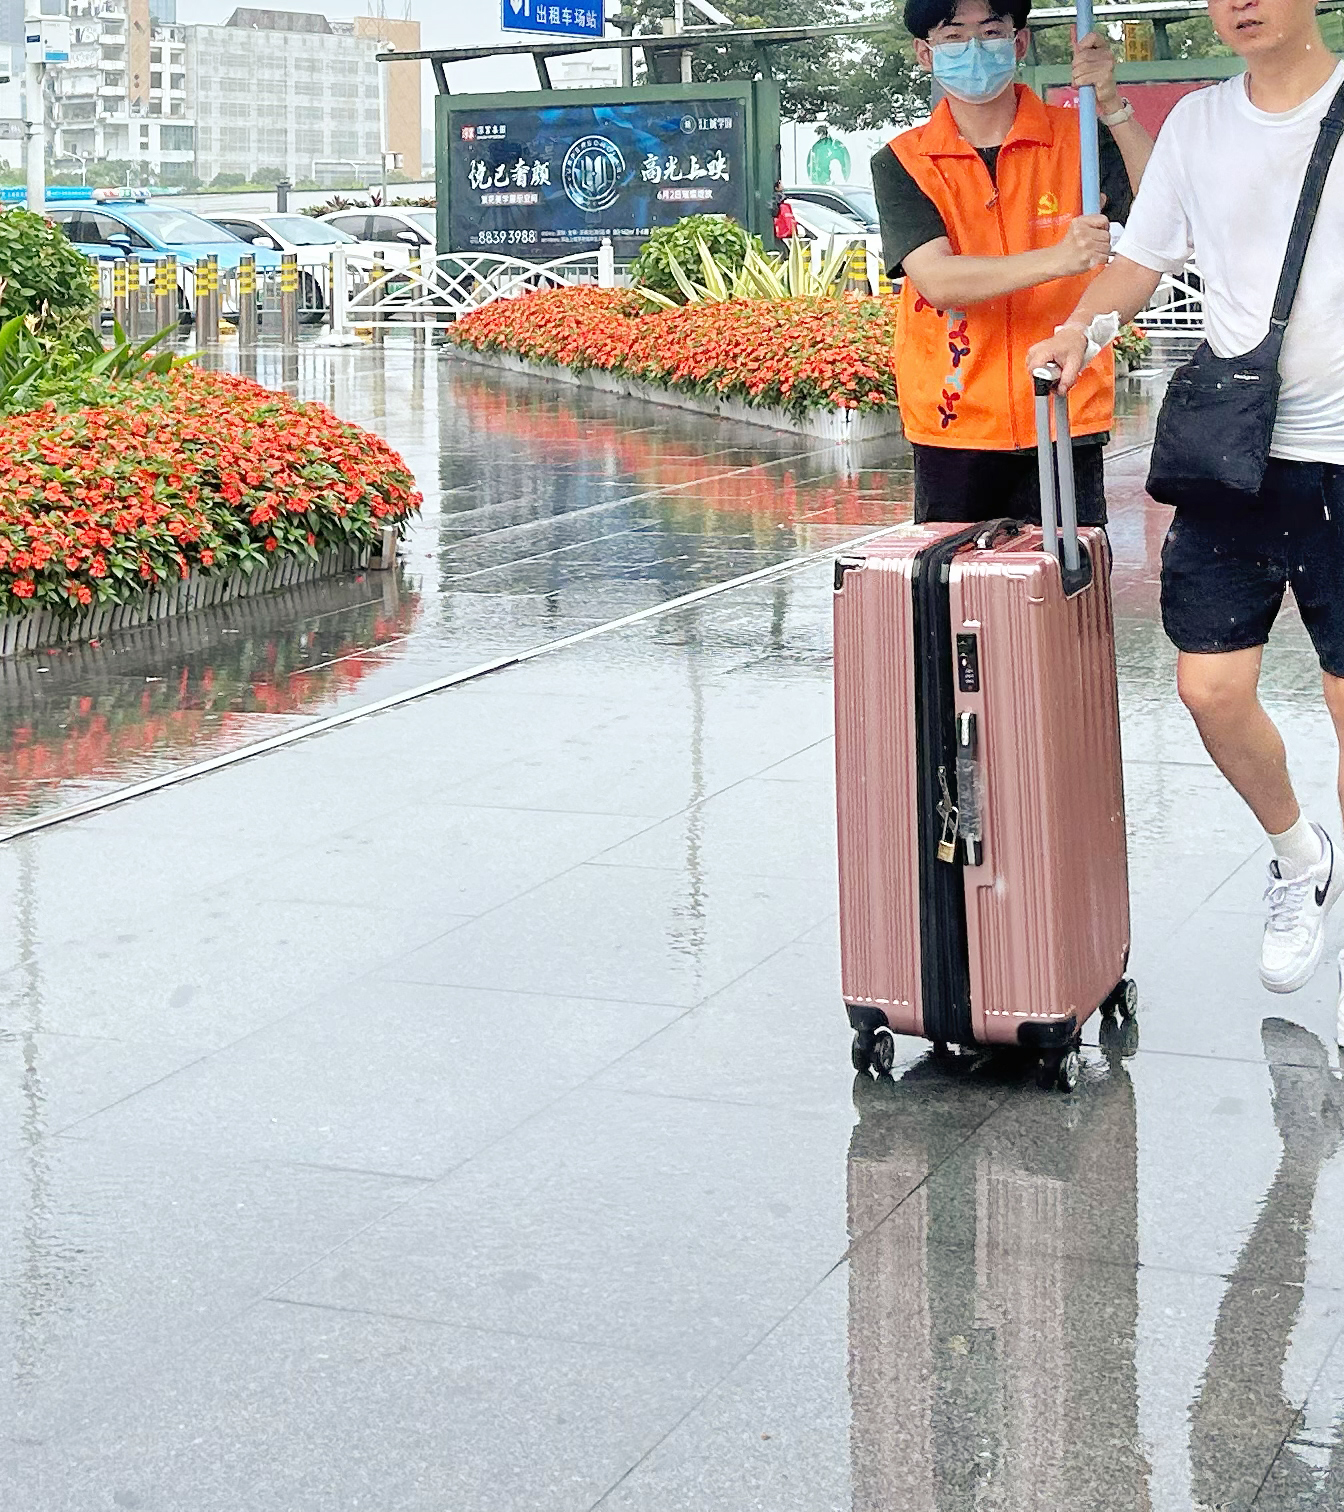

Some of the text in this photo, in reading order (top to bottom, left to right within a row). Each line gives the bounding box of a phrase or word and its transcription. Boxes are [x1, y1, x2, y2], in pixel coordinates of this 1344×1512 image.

[536, 4, 598, 29] 出租车场站
[478, 229, 536, 244] 88393988
